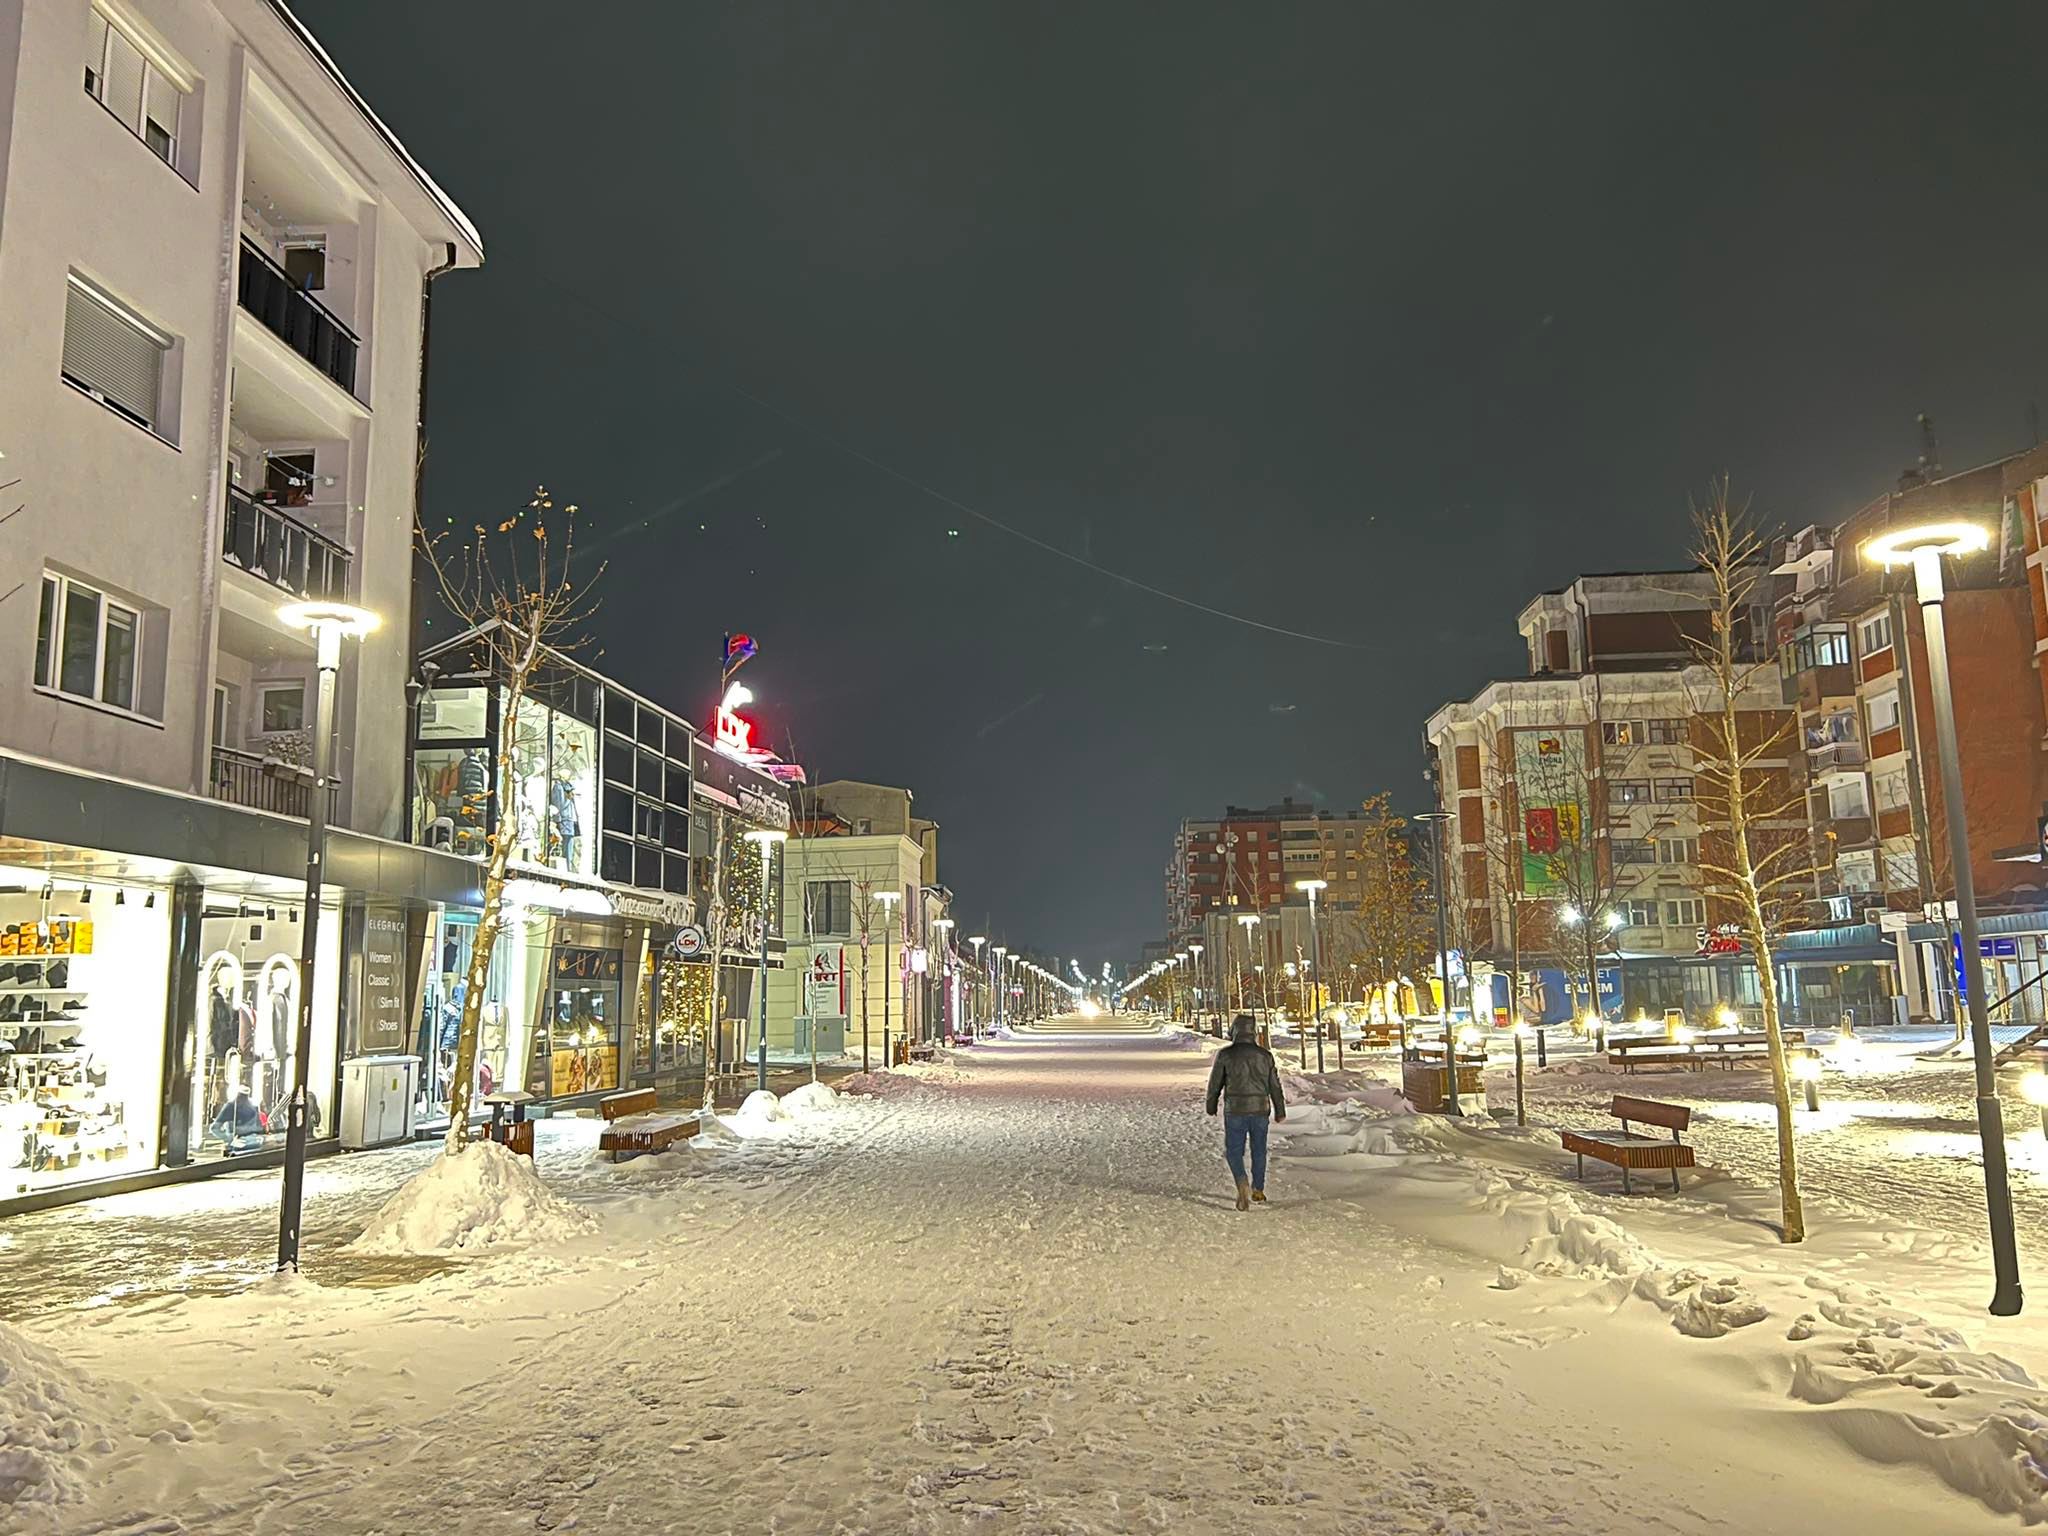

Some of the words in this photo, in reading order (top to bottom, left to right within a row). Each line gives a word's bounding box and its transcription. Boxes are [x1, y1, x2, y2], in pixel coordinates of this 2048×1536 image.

[678, 938, 698, 946] LDK
[368, 951, 392, 964] Women
[368, 974, 390, 986] Classic
[380, 1019, 398, 1031] Shoes
